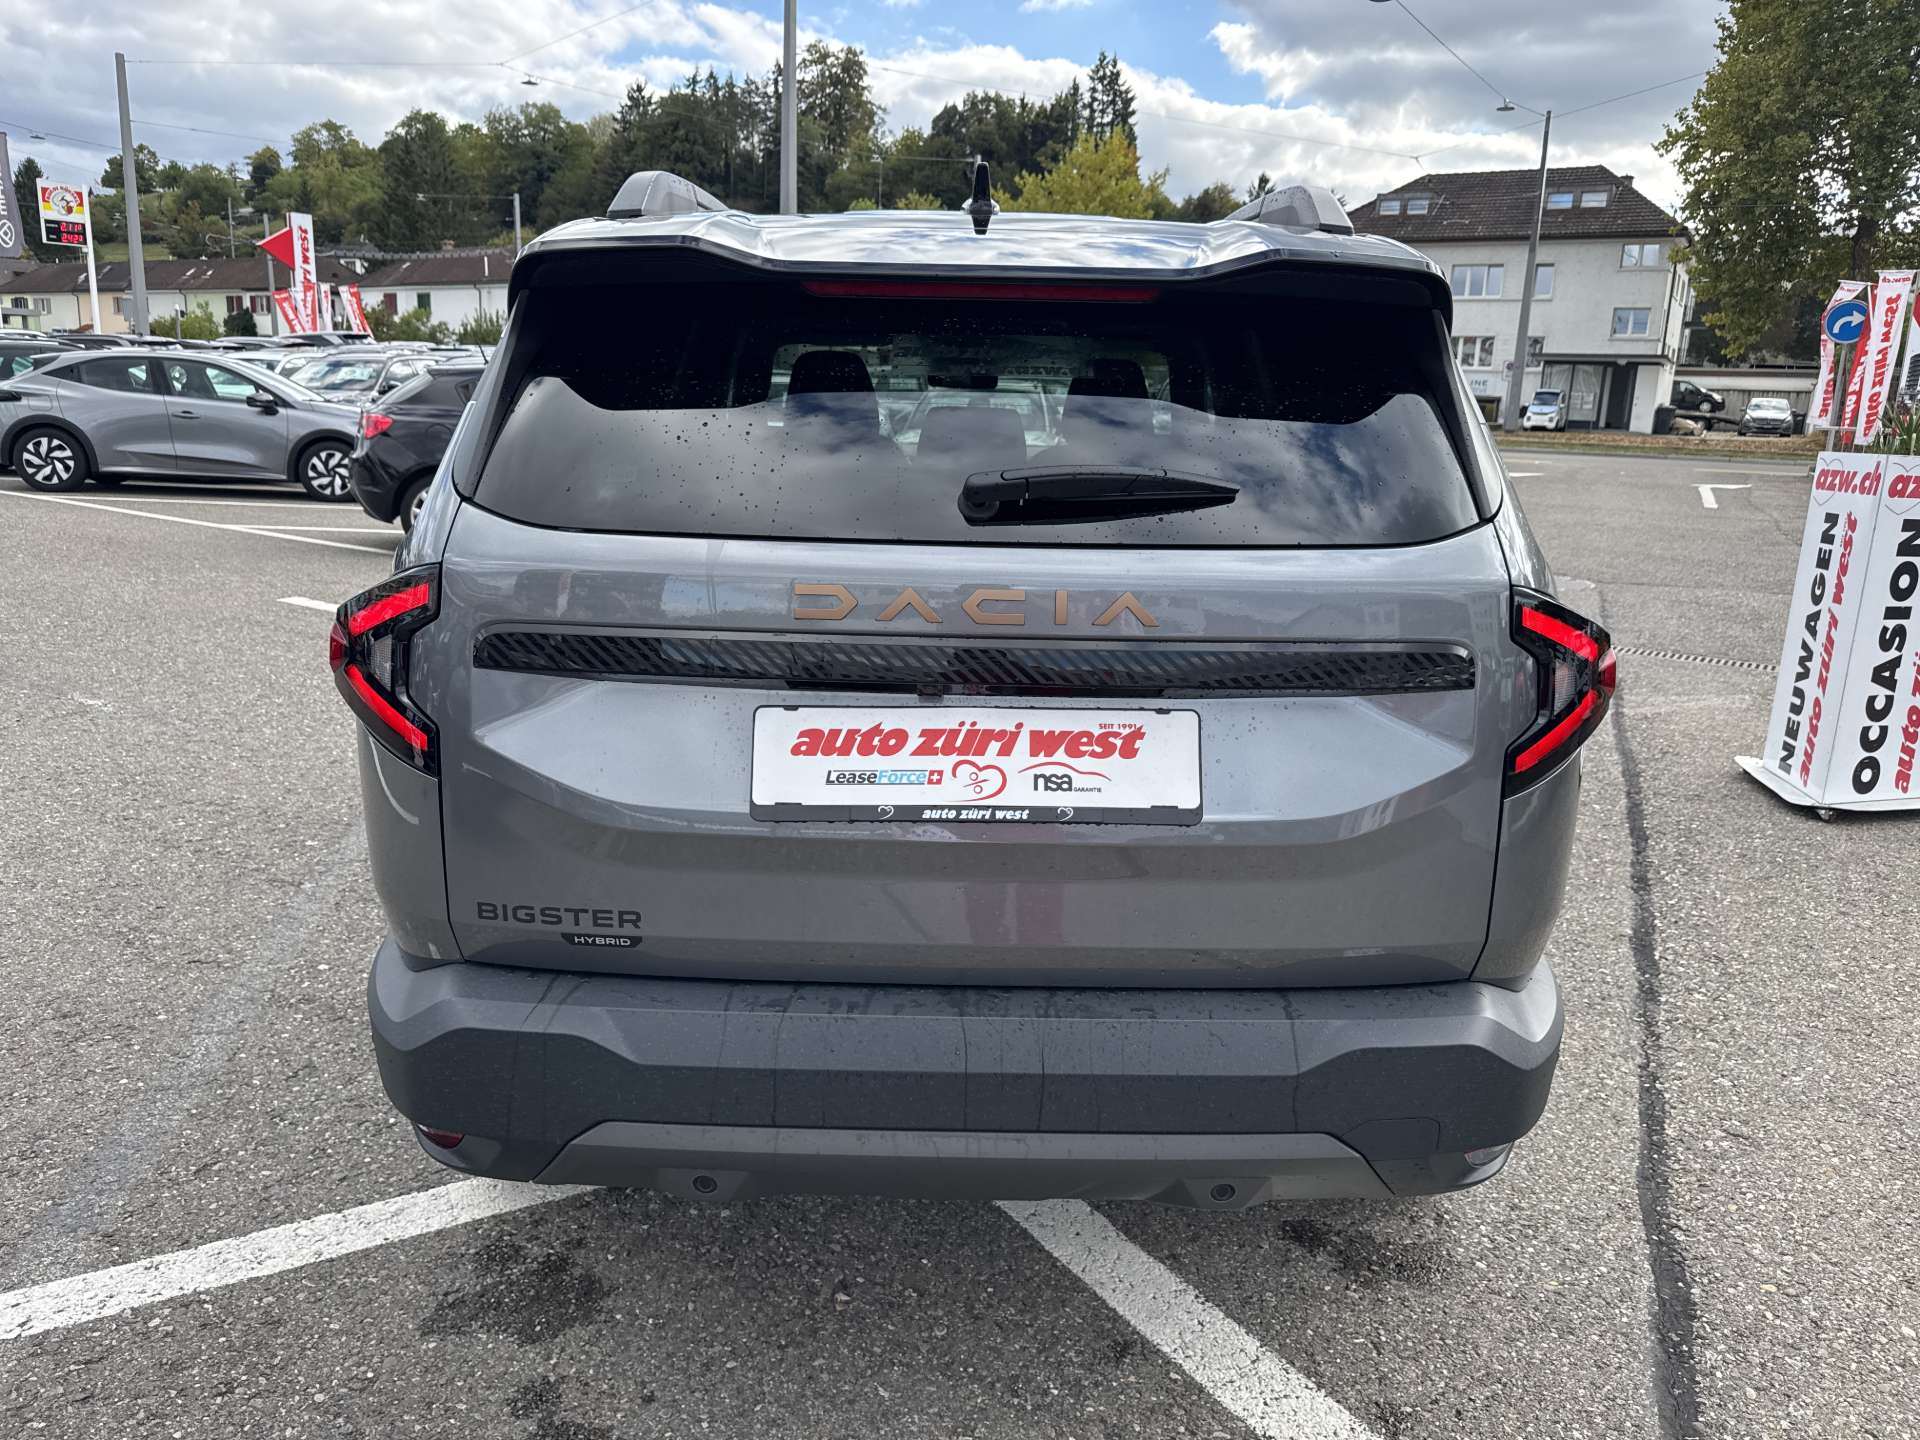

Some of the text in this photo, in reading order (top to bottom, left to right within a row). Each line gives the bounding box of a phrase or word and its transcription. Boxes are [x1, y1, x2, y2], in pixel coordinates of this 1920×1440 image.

[1815, 460, 1882, 497] azw.ch
[793, 583, 1161, 627] DACIA
[1778, 512, 1840, 776] NEUWAGEN
[1800, 510, 1858, 788] auto züri west
[1852, 518, 1920, 795] OCCASION
[790, 720, 1147, 760] auto züri west
[1117, 723, 1138, 731] 1991
[1895, 704, 1920, 794] auto
[826, 770, 927, 784] LeaseForce
[1033, 773, 1073, 792] nsa
[921, 807, 1030, 820] auto züri west
[476, 901, 642, 929] BIGSTER
[574, 935, 631, 946] HYBRID
